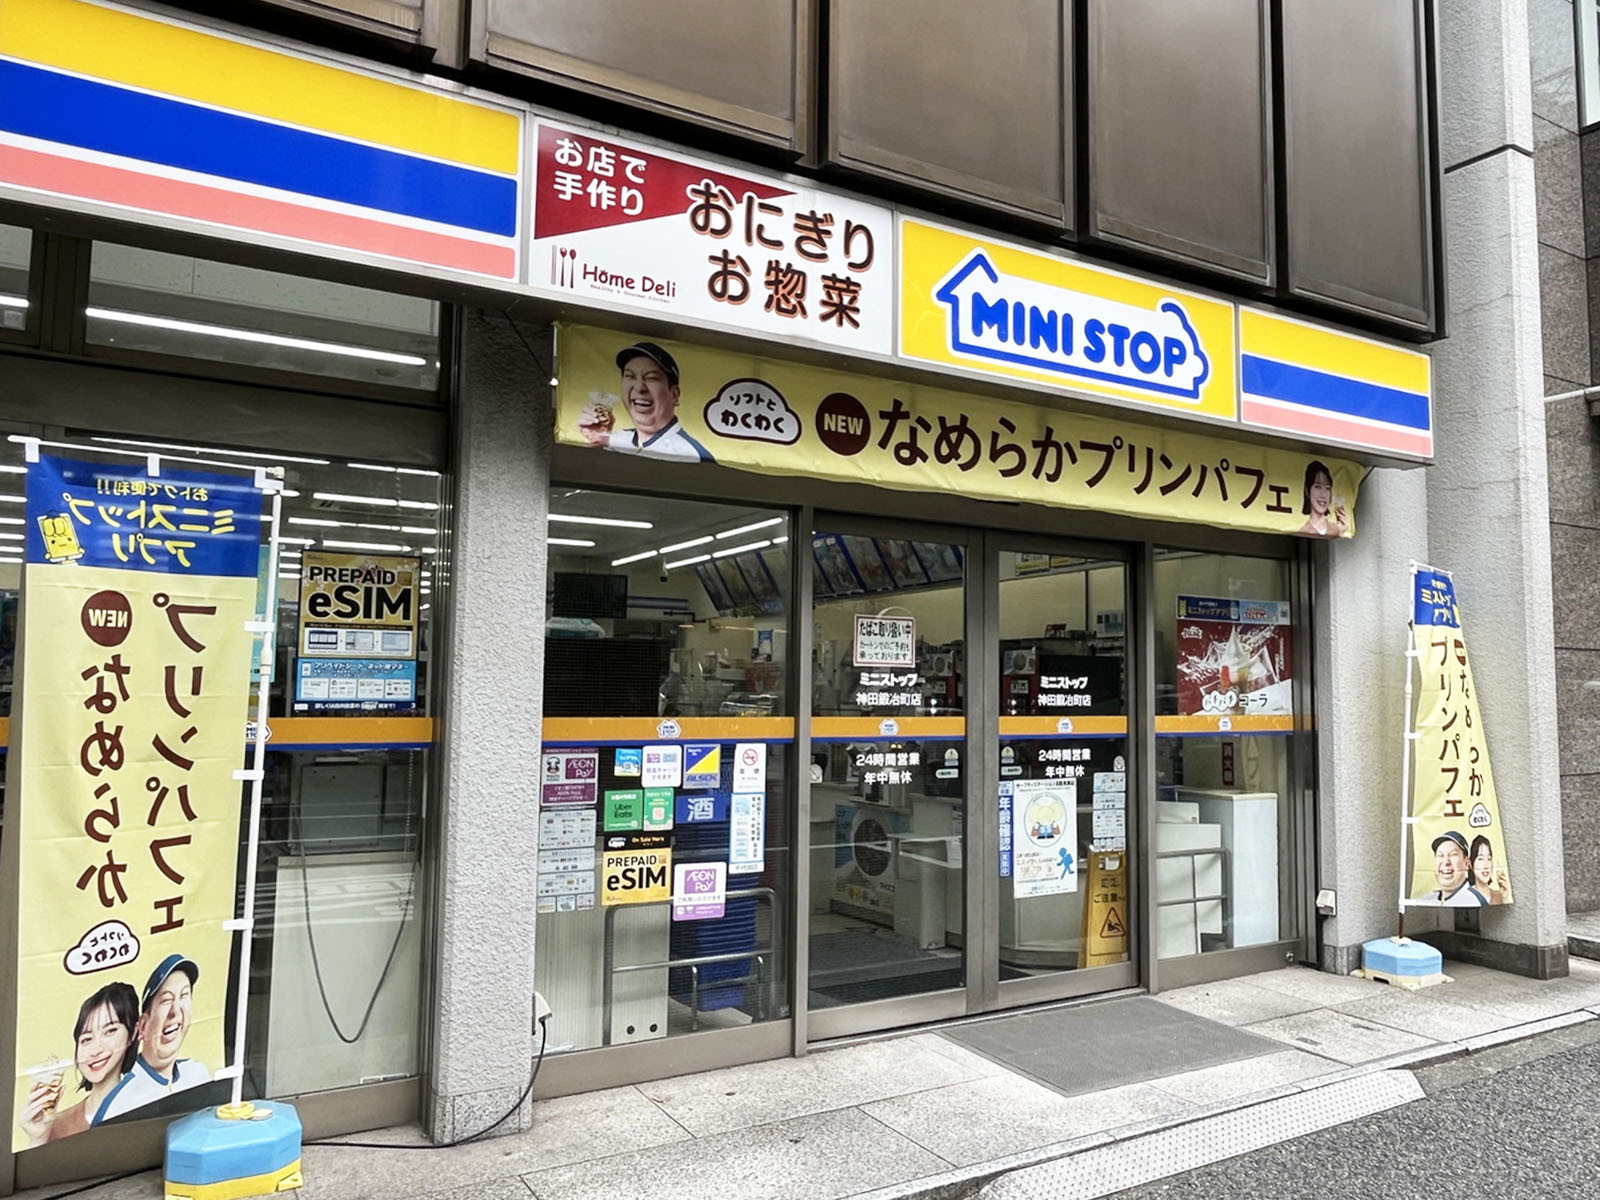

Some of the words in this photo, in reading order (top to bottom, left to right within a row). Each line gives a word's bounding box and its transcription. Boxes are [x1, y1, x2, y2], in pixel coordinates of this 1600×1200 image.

[554, 138, 648, 183] お店で
[552, 171, 644, 216] 手作り
[690, 182, 875, 272] おにぎり
[583, 263, 635, 289] Home
[642, 276, 676, 297] Deli
[707, 249, 862, 329] お惣菜
[971, 291, 1073, 356] MINI
[1084, 317, 1188, 378] STOP
[729, 393, 777, 411] ソフトと
[721, 409, 786, 435] わくわく
[823, 413, 864, 436] NEW
[878, 399, 1293, 514] なめらかプリンパフェ
[309, 566, 396, 585] PREPAID
[308, 585, 413, 621] eSIM
[860, 672, 918, 687] ミニストップ
[1040, 675, 1088, 689] ミニストップ
[856, 752, 920, 767] 24時間営業
[1038, 749, 1091, 762] 24時間営業
[864, 770, 912, 785] 年中無休
[1045, 765, 1085, 778] 年中無休
[688, 797, 715, 821] 酒
[607, 855, 657, 868] PREPAID
[607, 866, 666, 891] eSIM
